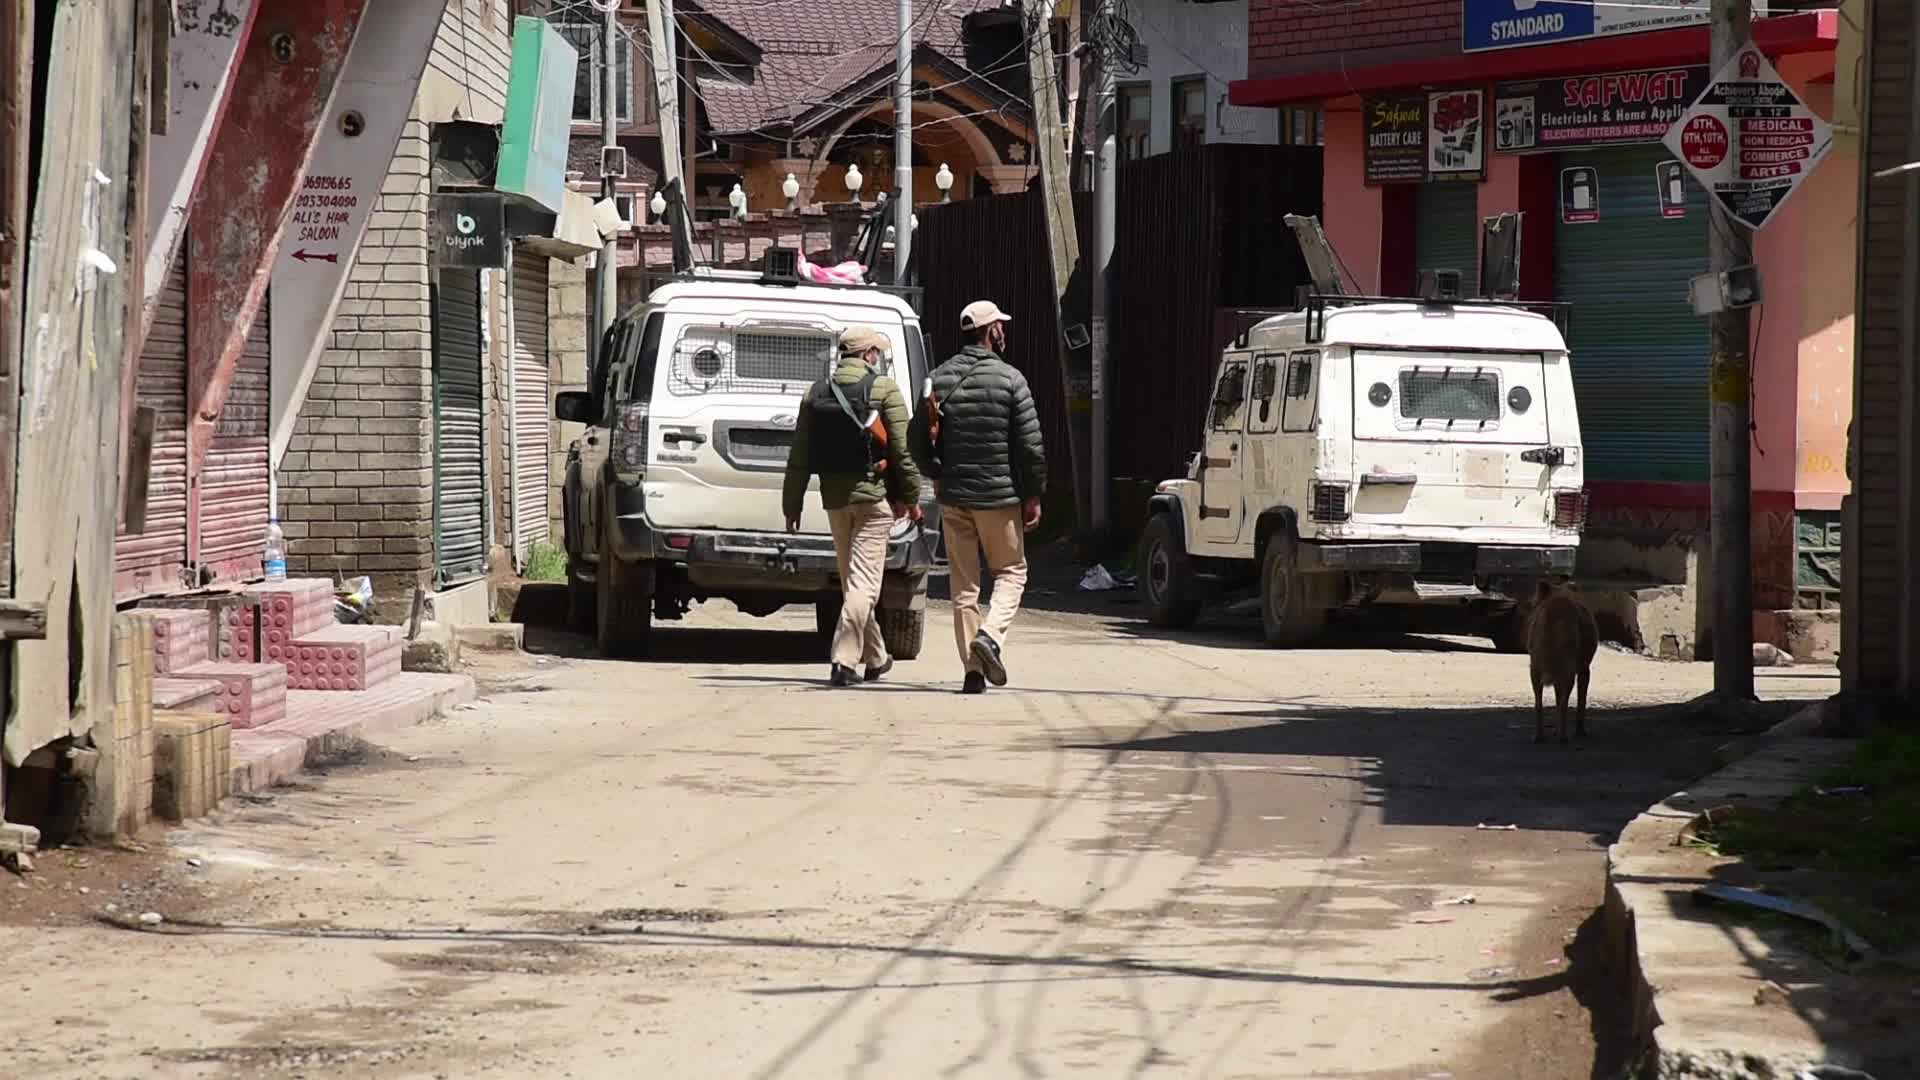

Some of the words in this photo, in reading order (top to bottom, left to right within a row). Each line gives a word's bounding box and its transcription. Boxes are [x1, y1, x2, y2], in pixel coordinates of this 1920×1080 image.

[1491, 13, 1564, 40] STANDARD
[1563, 70, 1688, 107] SAFWAT
[1713, 84, 1756, 97] Achievers
[1758, 84, 1786, 97] Abode
[1372, 101, 1420, 130] Safwat
[1541, 110, 1597, 126] Electricals
[1602, 110, 1611, 123] &
[1616, 107, 1646, 122] Home
[1544, 127, 1585, 140] ELECTRIC
[1586, 125, 1621, 138] FITTERS
[1621, 124, 1641, 136] ARE
[1642, 122, 1666, 134] ALSO
[1748, 119, 1805, 131] MEDICAL
[1369, 132, 1400, 147] BATTERY
[1402, 131, 1422, 145] CARE
[1744, 137, 1765, 147] NON
[1766, 135, 1809, 147] MEDICAL
[1744, 149, 1804, 162] COMMERCE
[1750, 166, 1791, 177] ARTS
[298, 226, 339, 241] SALOON
[446, 235, 485, 249] blynk
